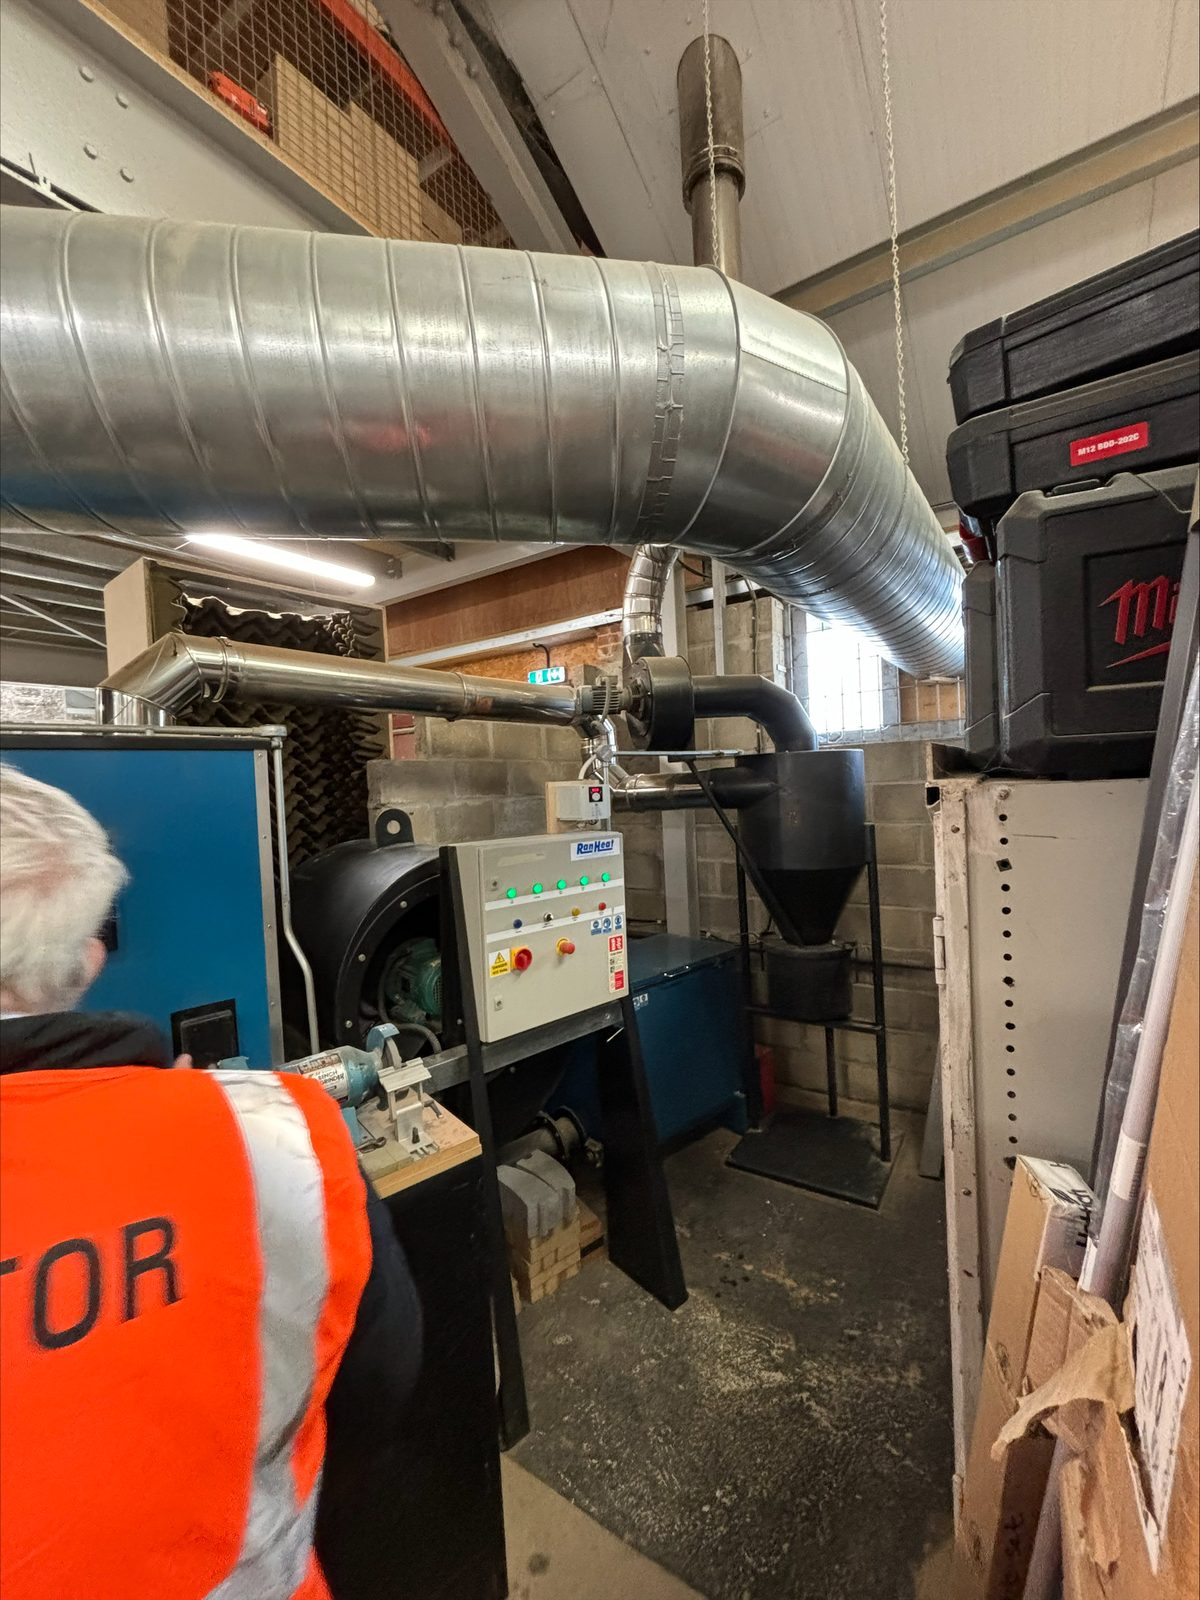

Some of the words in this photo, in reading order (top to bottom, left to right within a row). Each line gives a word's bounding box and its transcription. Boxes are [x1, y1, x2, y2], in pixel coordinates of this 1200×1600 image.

[1077, 444, 1096, 456] M12
[1097, 432, 1140, 451] BDD-202C
[0, 1216, 180, 1350] OR
